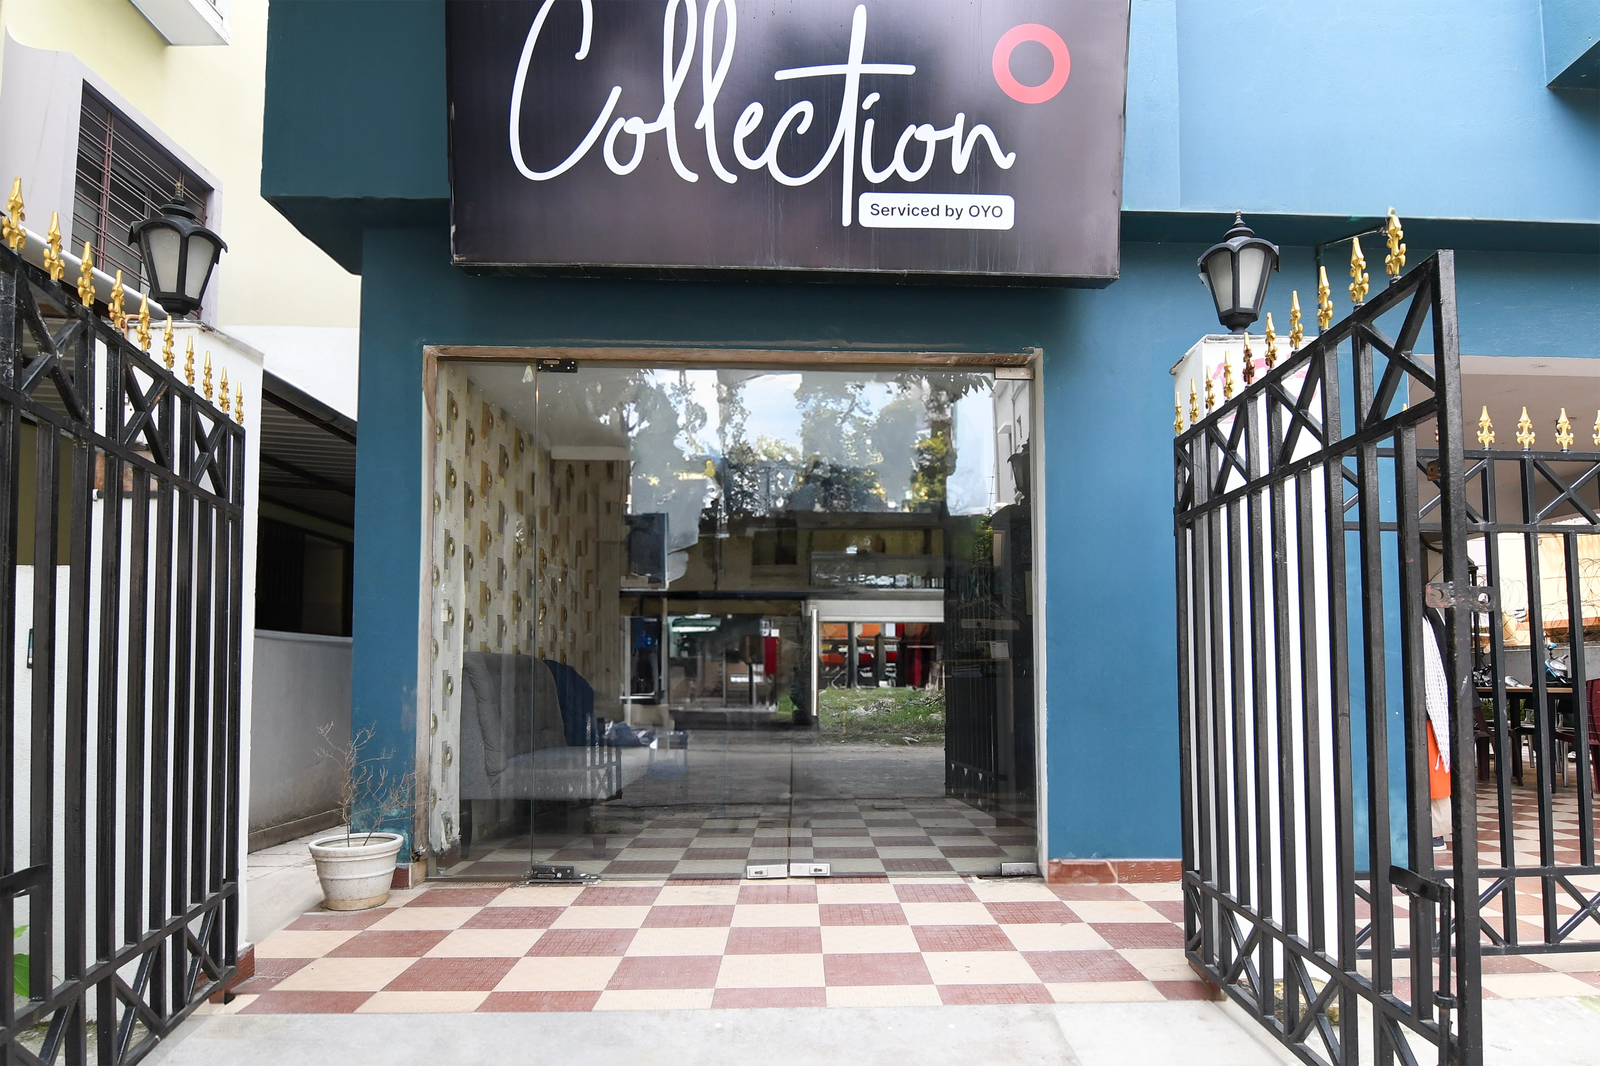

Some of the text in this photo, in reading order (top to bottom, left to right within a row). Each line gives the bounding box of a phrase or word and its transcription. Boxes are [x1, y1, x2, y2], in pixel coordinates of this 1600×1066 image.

[509, 0, 1016, 226] Collection
[869, 202, 1004, 221] Serviced by OYO
